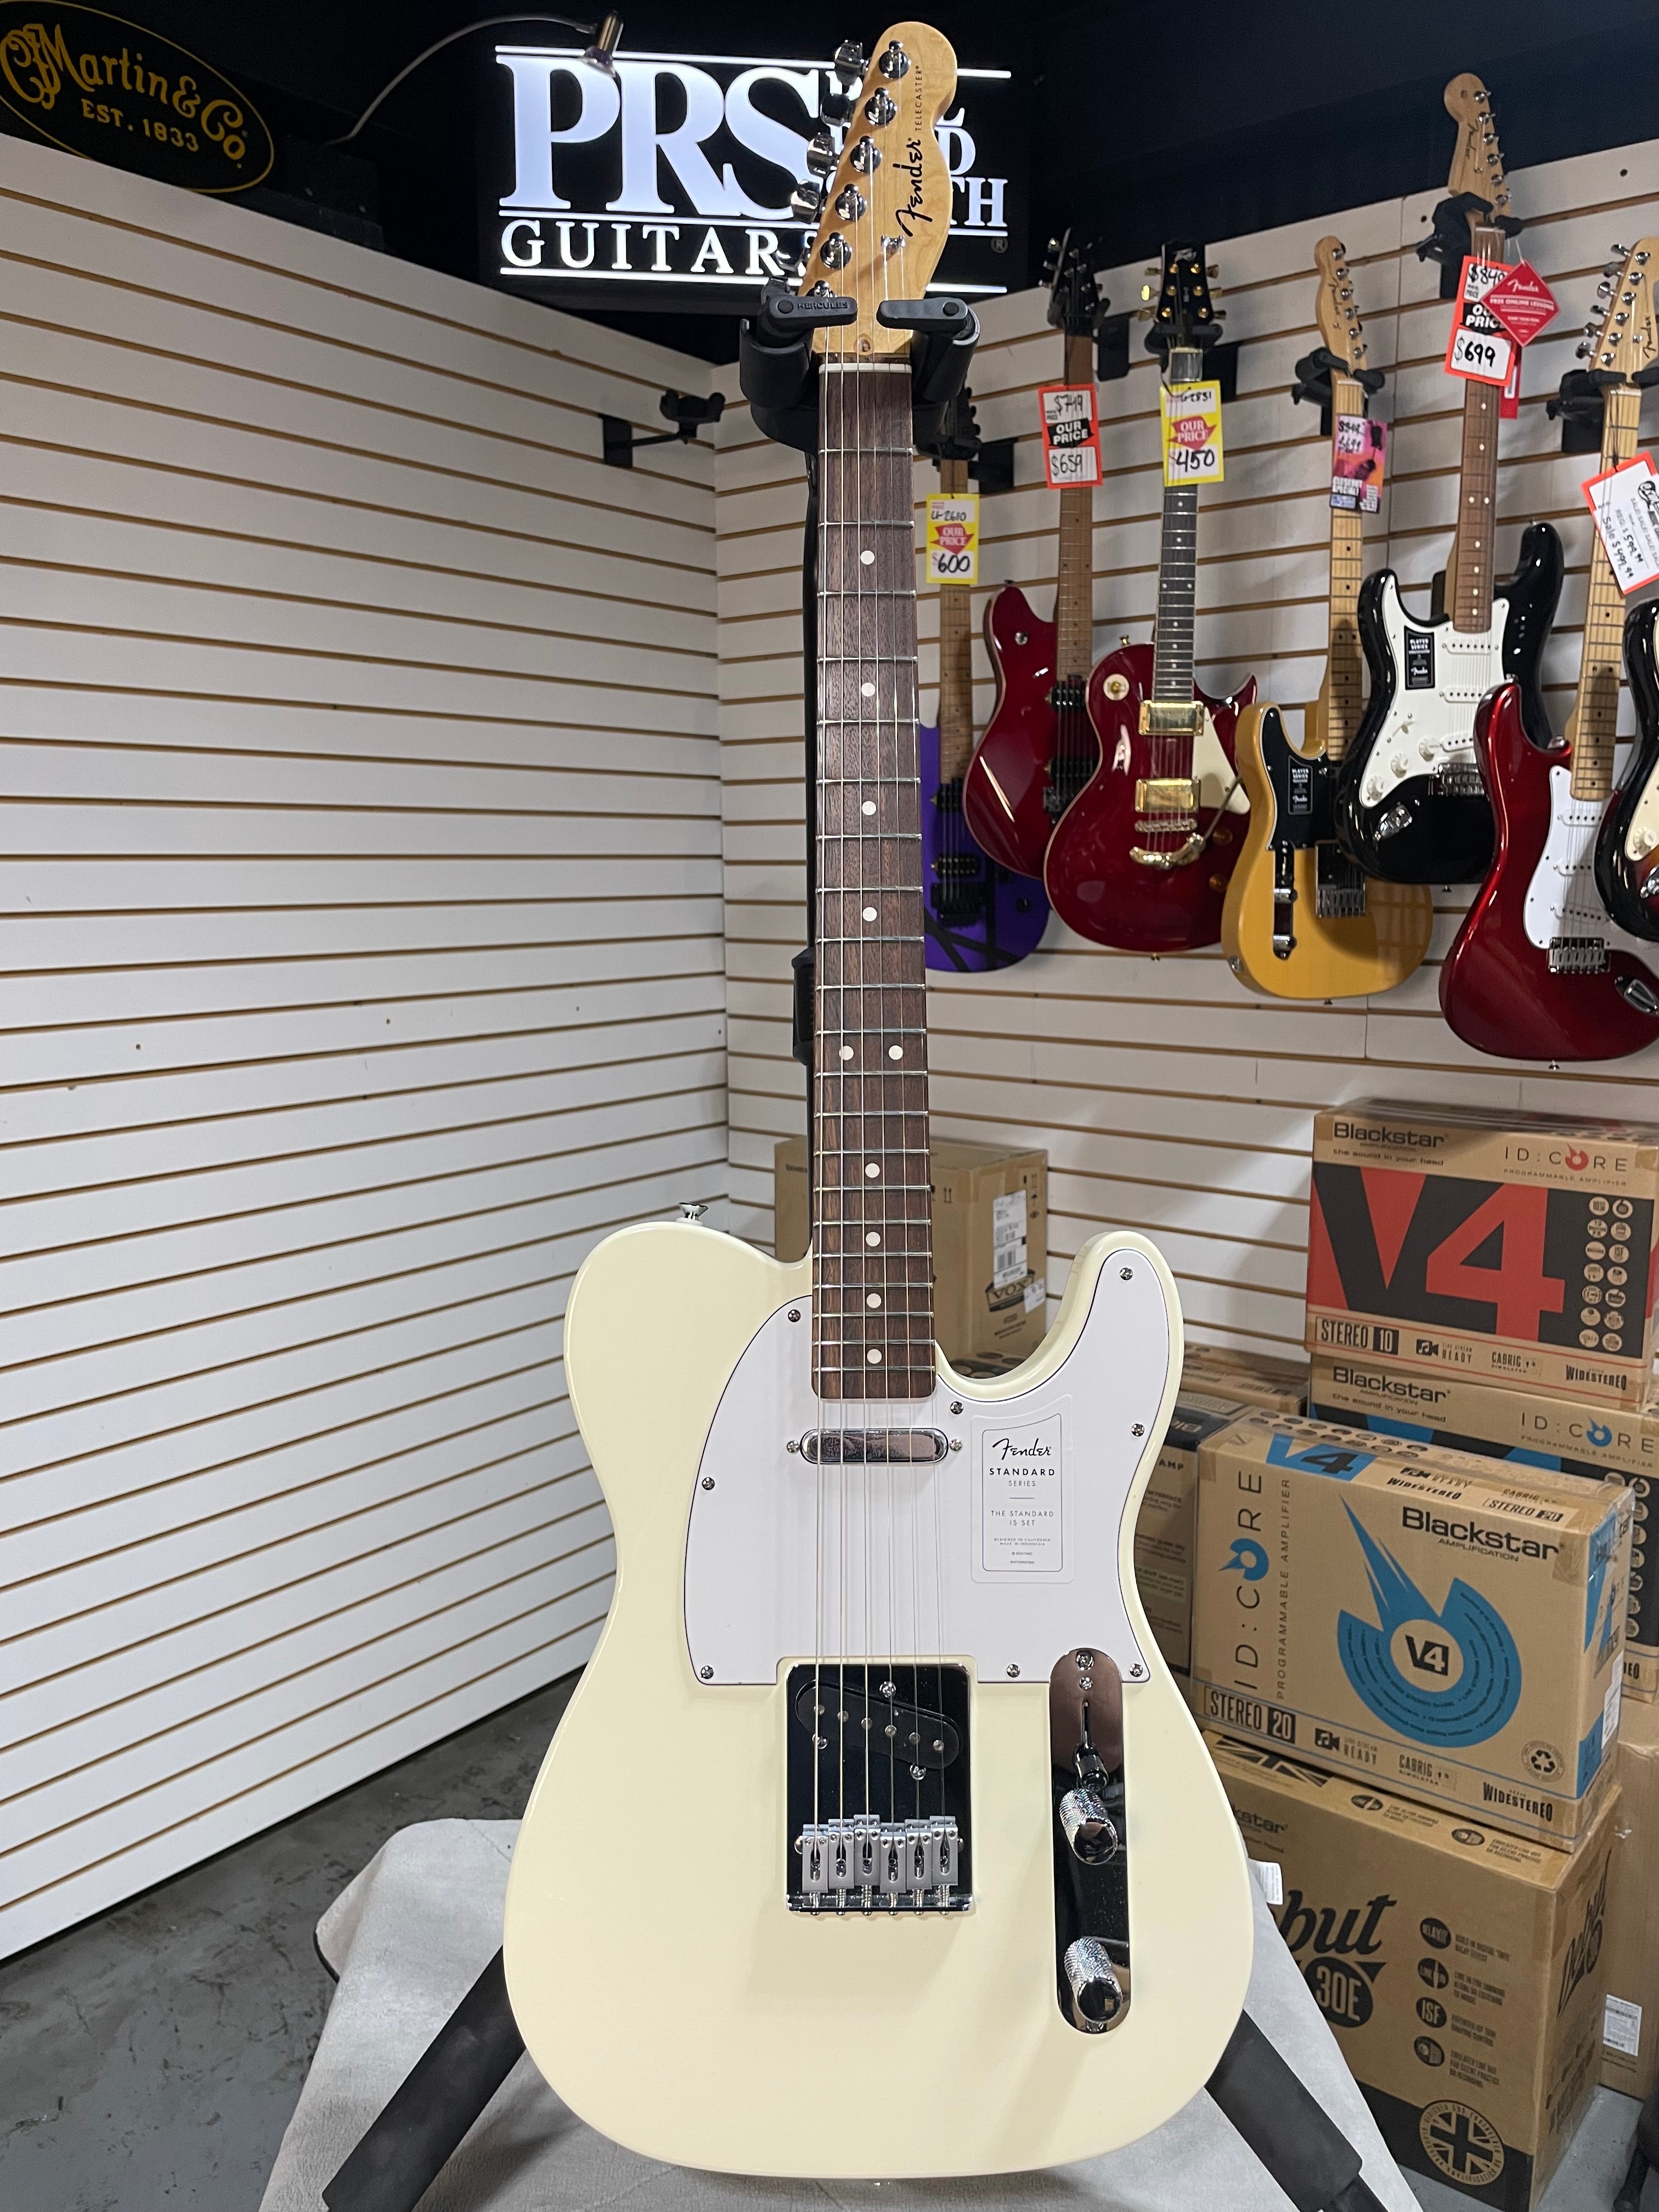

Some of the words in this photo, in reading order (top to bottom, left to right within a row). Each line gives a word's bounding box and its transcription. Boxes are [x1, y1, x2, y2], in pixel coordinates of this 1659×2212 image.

[915, 65, 923, 131] TELECASTER
[81, 98, 134, 132] EST.
[143, 119, 199, 152] 1833
[496, 53, 819, 221] PRS
[893, 138, 933, 237] Fender
[797, 301, 848, 310] HERCULES
[1454, 336, 1496, 368] $699
[1053, 428, 1089, 445] PRICE
[1056, 421, 1081, 435] OUR
[1177, 430, 1207, 442] PRICE
[1181, 420, 1205, 432] OUR
[1051, 454, 1083, 476] $659
[939, 537, 967, 546] PRICE
[943, 527, 964, 537] OUR
[1601, 517, 1618, 540] Sale
[1334, 1121, 1445, 1148] Blackstar
[1314, 1162, 1565, 1342] V4
[991, 1279, 1029, 1300] VOX
[1321, 1318, 1369, 1349] STEREO
[1380, 1329, 1393, 1353] 10
[1442, 1350, 1472, 1364] READY
[1333, 1366, 1447, 1403] Blackstar
[1566, 1365, 1627, 1391] WIDESTEREO
[992, 1438, 1051, 1460] Fender
[1266, 1433, 1378, 1481] V4
[990, 1468, 1055, 1476] STANDARD
[1159, 1458, 1184, 1471] AMP
[1489, 1499, 1536, 1516] STEREO
[1281, 1479, 1290, 1563] AMPLIFIER
[1402, 1506, 1559, 1560] Blackstar
[1438, 1537, 1519, 1562] AMPLIFICATION
[1277, 1570, 1289, 1700] PROGRAMMABLE
[1405, 1634, 1449, 1676] V4
[1210, 1691, 1262, 1730] STEREO
[1272, 1711, 1291, 1740] 20
[1483, 1781, 1553, 1822] WIDESTEREO
[1279, 1889, 1398, 1955] but
[1316, 1965, 1362, 2022] 30E
[1421, 2000, 1440, 2024] ISF
